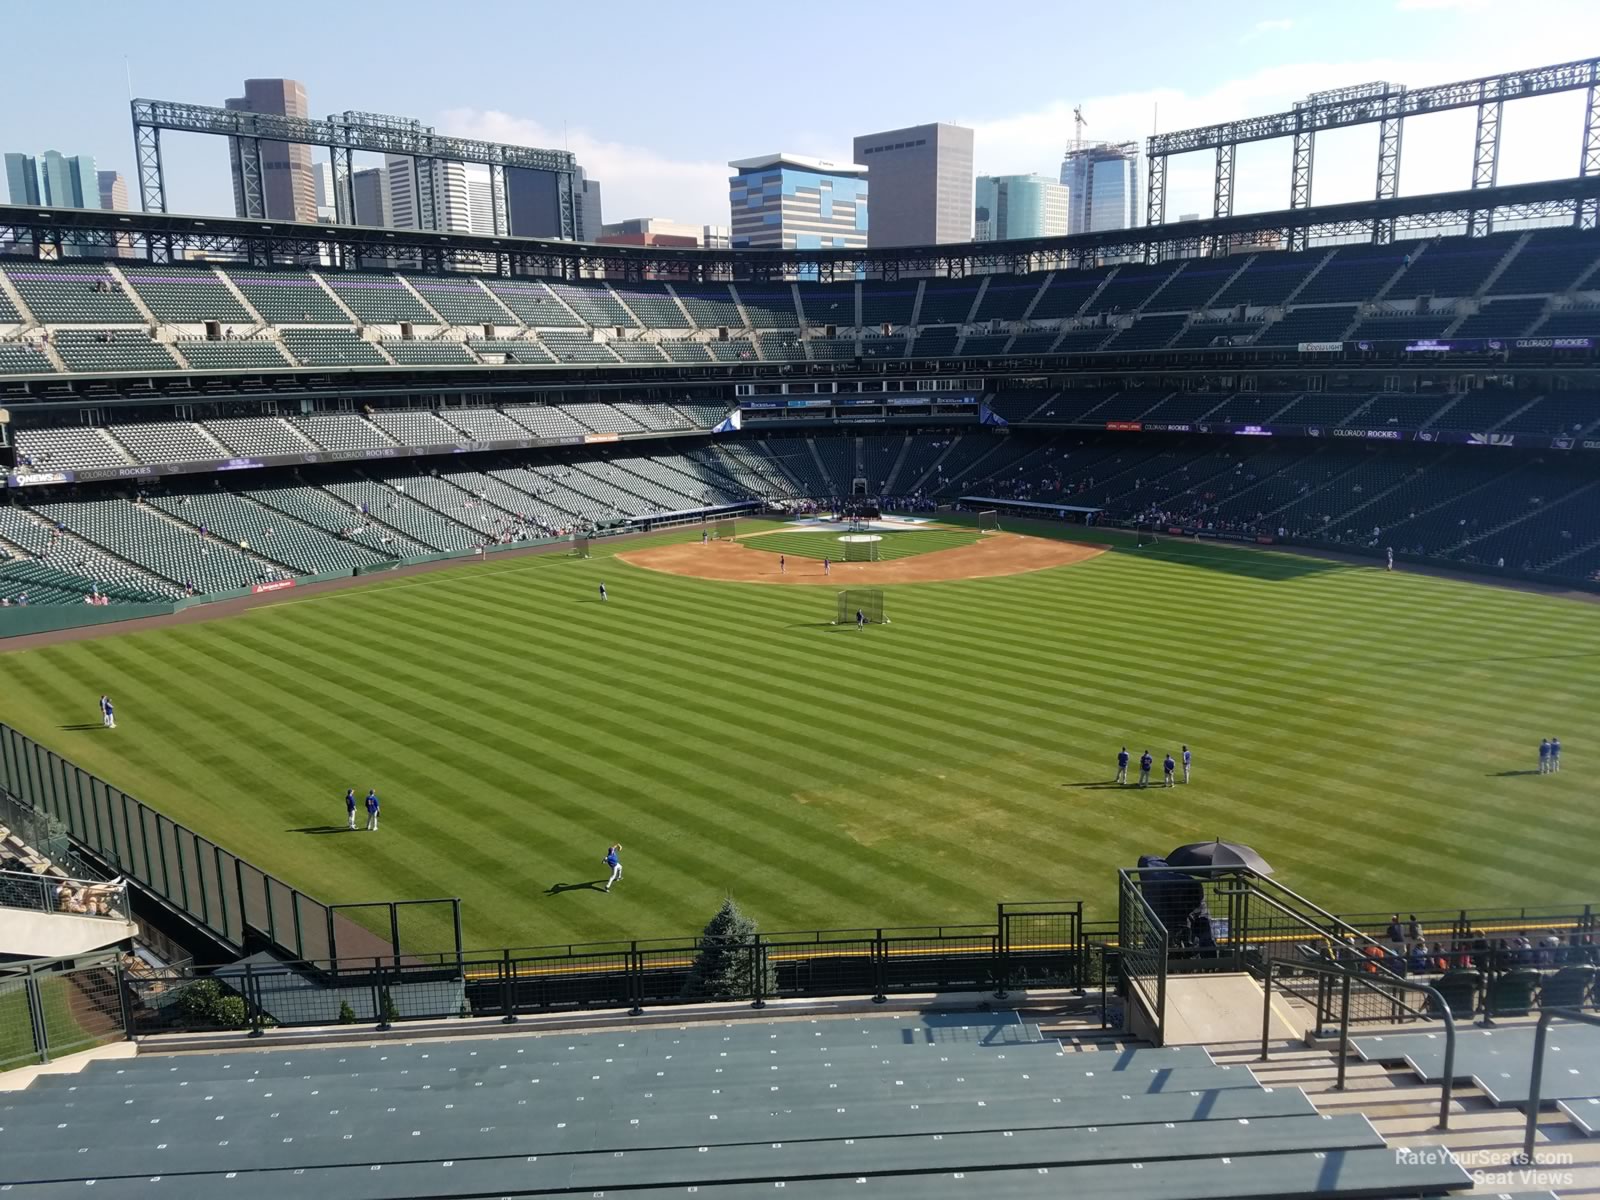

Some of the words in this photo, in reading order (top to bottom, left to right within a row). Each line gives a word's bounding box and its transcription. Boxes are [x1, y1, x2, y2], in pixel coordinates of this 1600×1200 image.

[1516, 340, 1552, 348] COLORADO
[1554, 339, 1589, 347] ROCKIES
[1333, 429, 1366, 437] COLORADO
[1367, 430, 1398, 438] ROCKIES
[331, 450, 364, 460] COLORADO
[366, 448, 394, 457] ROCKIES
[80, 469, 117, 479] COLORADO
[119, 466, 151, 476] ROCKIES
[16, 473, 54, 487] 9NEWS
